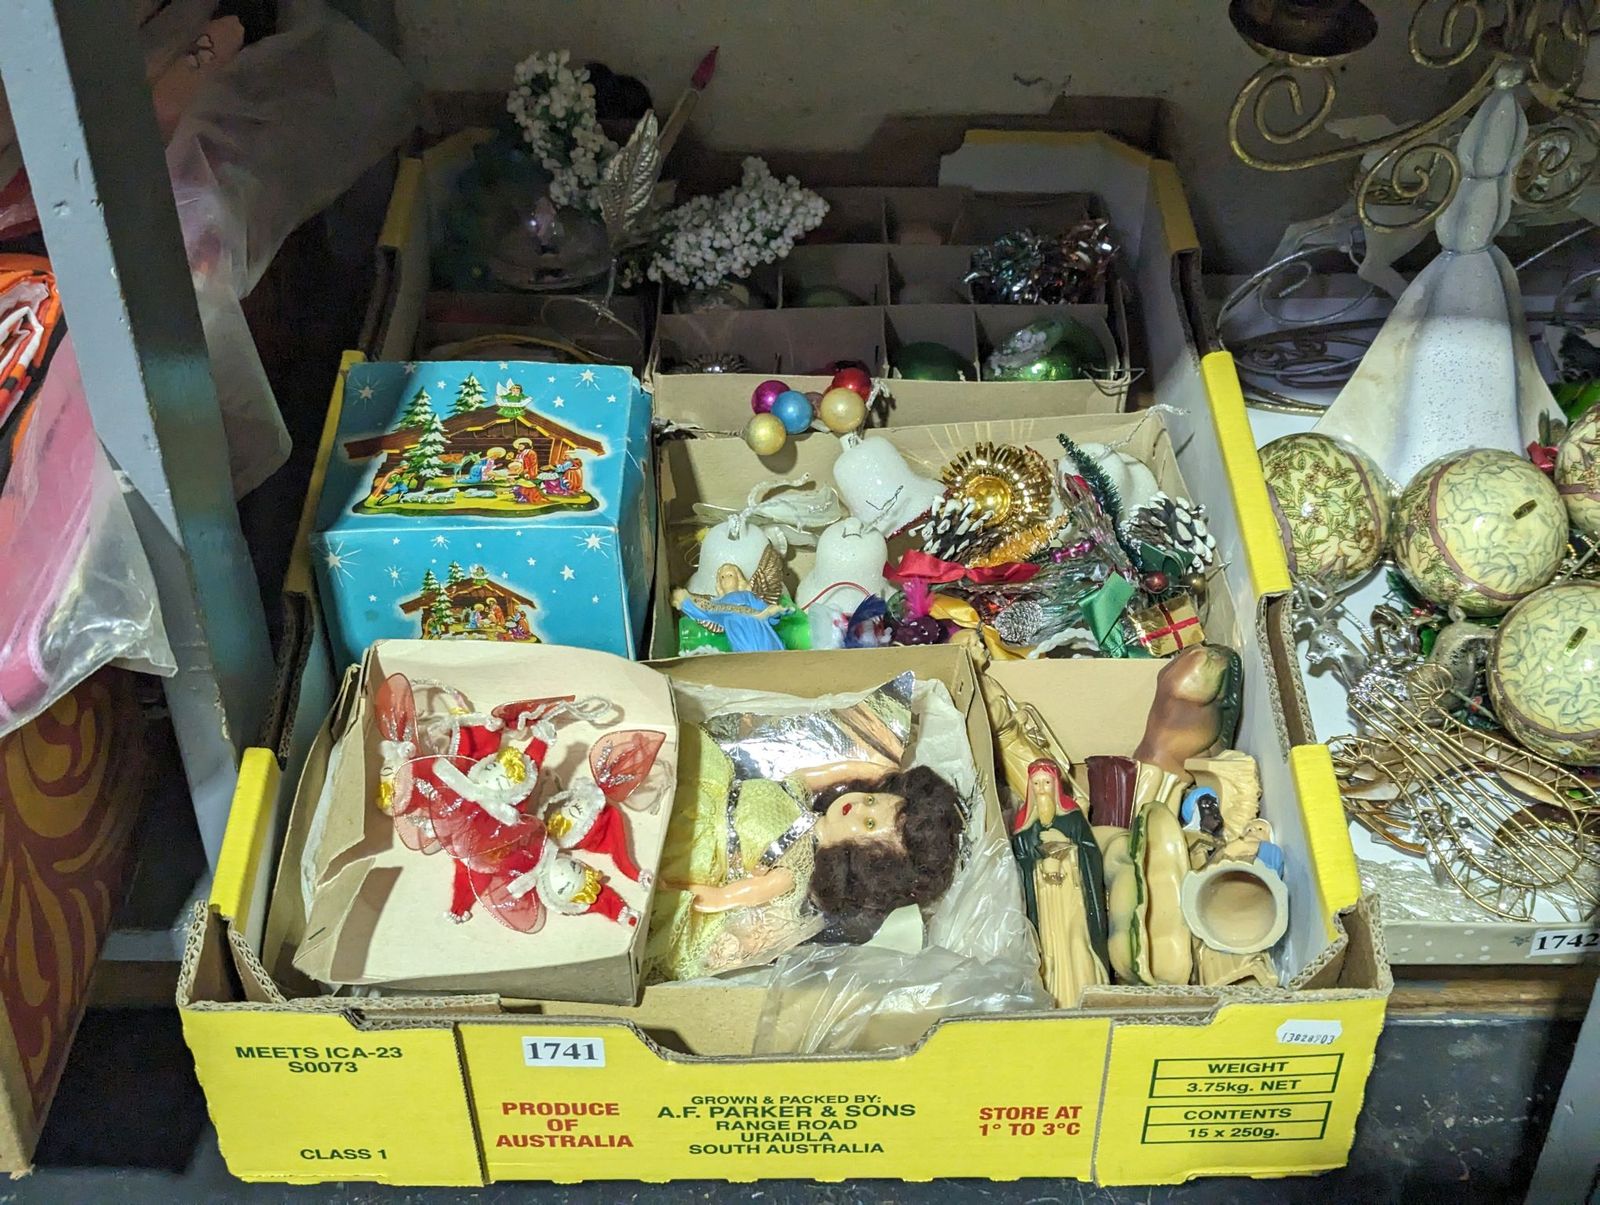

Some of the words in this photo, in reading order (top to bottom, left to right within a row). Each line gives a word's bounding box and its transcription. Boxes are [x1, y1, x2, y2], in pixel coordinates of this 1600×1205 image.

[1535, 932, 1600, 950] 1742
[235, 1046, 318, 1059] MEETS
[324, 1046, 403, 1059] ICA-23
[526, 1042, 599, 1061] 1741
[288, 1061, 359, 1074] S0073
[1207, 1061, 1290, 1074] WEIGHT
[1186, 1082, 1254, 1095] 3.75kg.
[1260, 1079, 1302, 1092] NET
[690, 1095, 758, 1105] GROWN
[763, 1095, 774, 1105] &
[779, 1095, 849, 1104] PACKED
[855, 1094, 881, 1104] BY:
[501, 1102, 620, 1116] PRODUCE
[657, 1106, 701, 1119] A.F.
[709, 1105, 813, 1119] PARKER
[820, 1106, 838, 1118] &
[845, 1103, 917, 1118] SONS
[978, 1106, 1050, 1121] STORE
[1055, 1105, 1084, 1119] AT
[1182, 1107, 1293, 1121] CONTENTS
[546, 1118, 579, 1132] OF
[715, 1120, 789, 1132] RANGE
[796, 1119, 858, 1131] ROAD
[1008, 1122, 1036, 1136] TO
[1041, 1121, 1082, 1136] 3°C
[740, 1131, 835, 1143] URAIDLA
[1187, 1127, 1208, 1139] 15
[1213, 1129, 1225, 1138] x
[1230, 1126, 1280, 1139] 250g.
[495, 1135, 634, 1148] AUSTRALIA
[299, 1148, 373, 1161] CLASS
[377, 1148, 387, 1160] 1
[688, 1143, 760, 1155] SOUTH
[765, 1142, 885, 1154] AUSTRALIA
